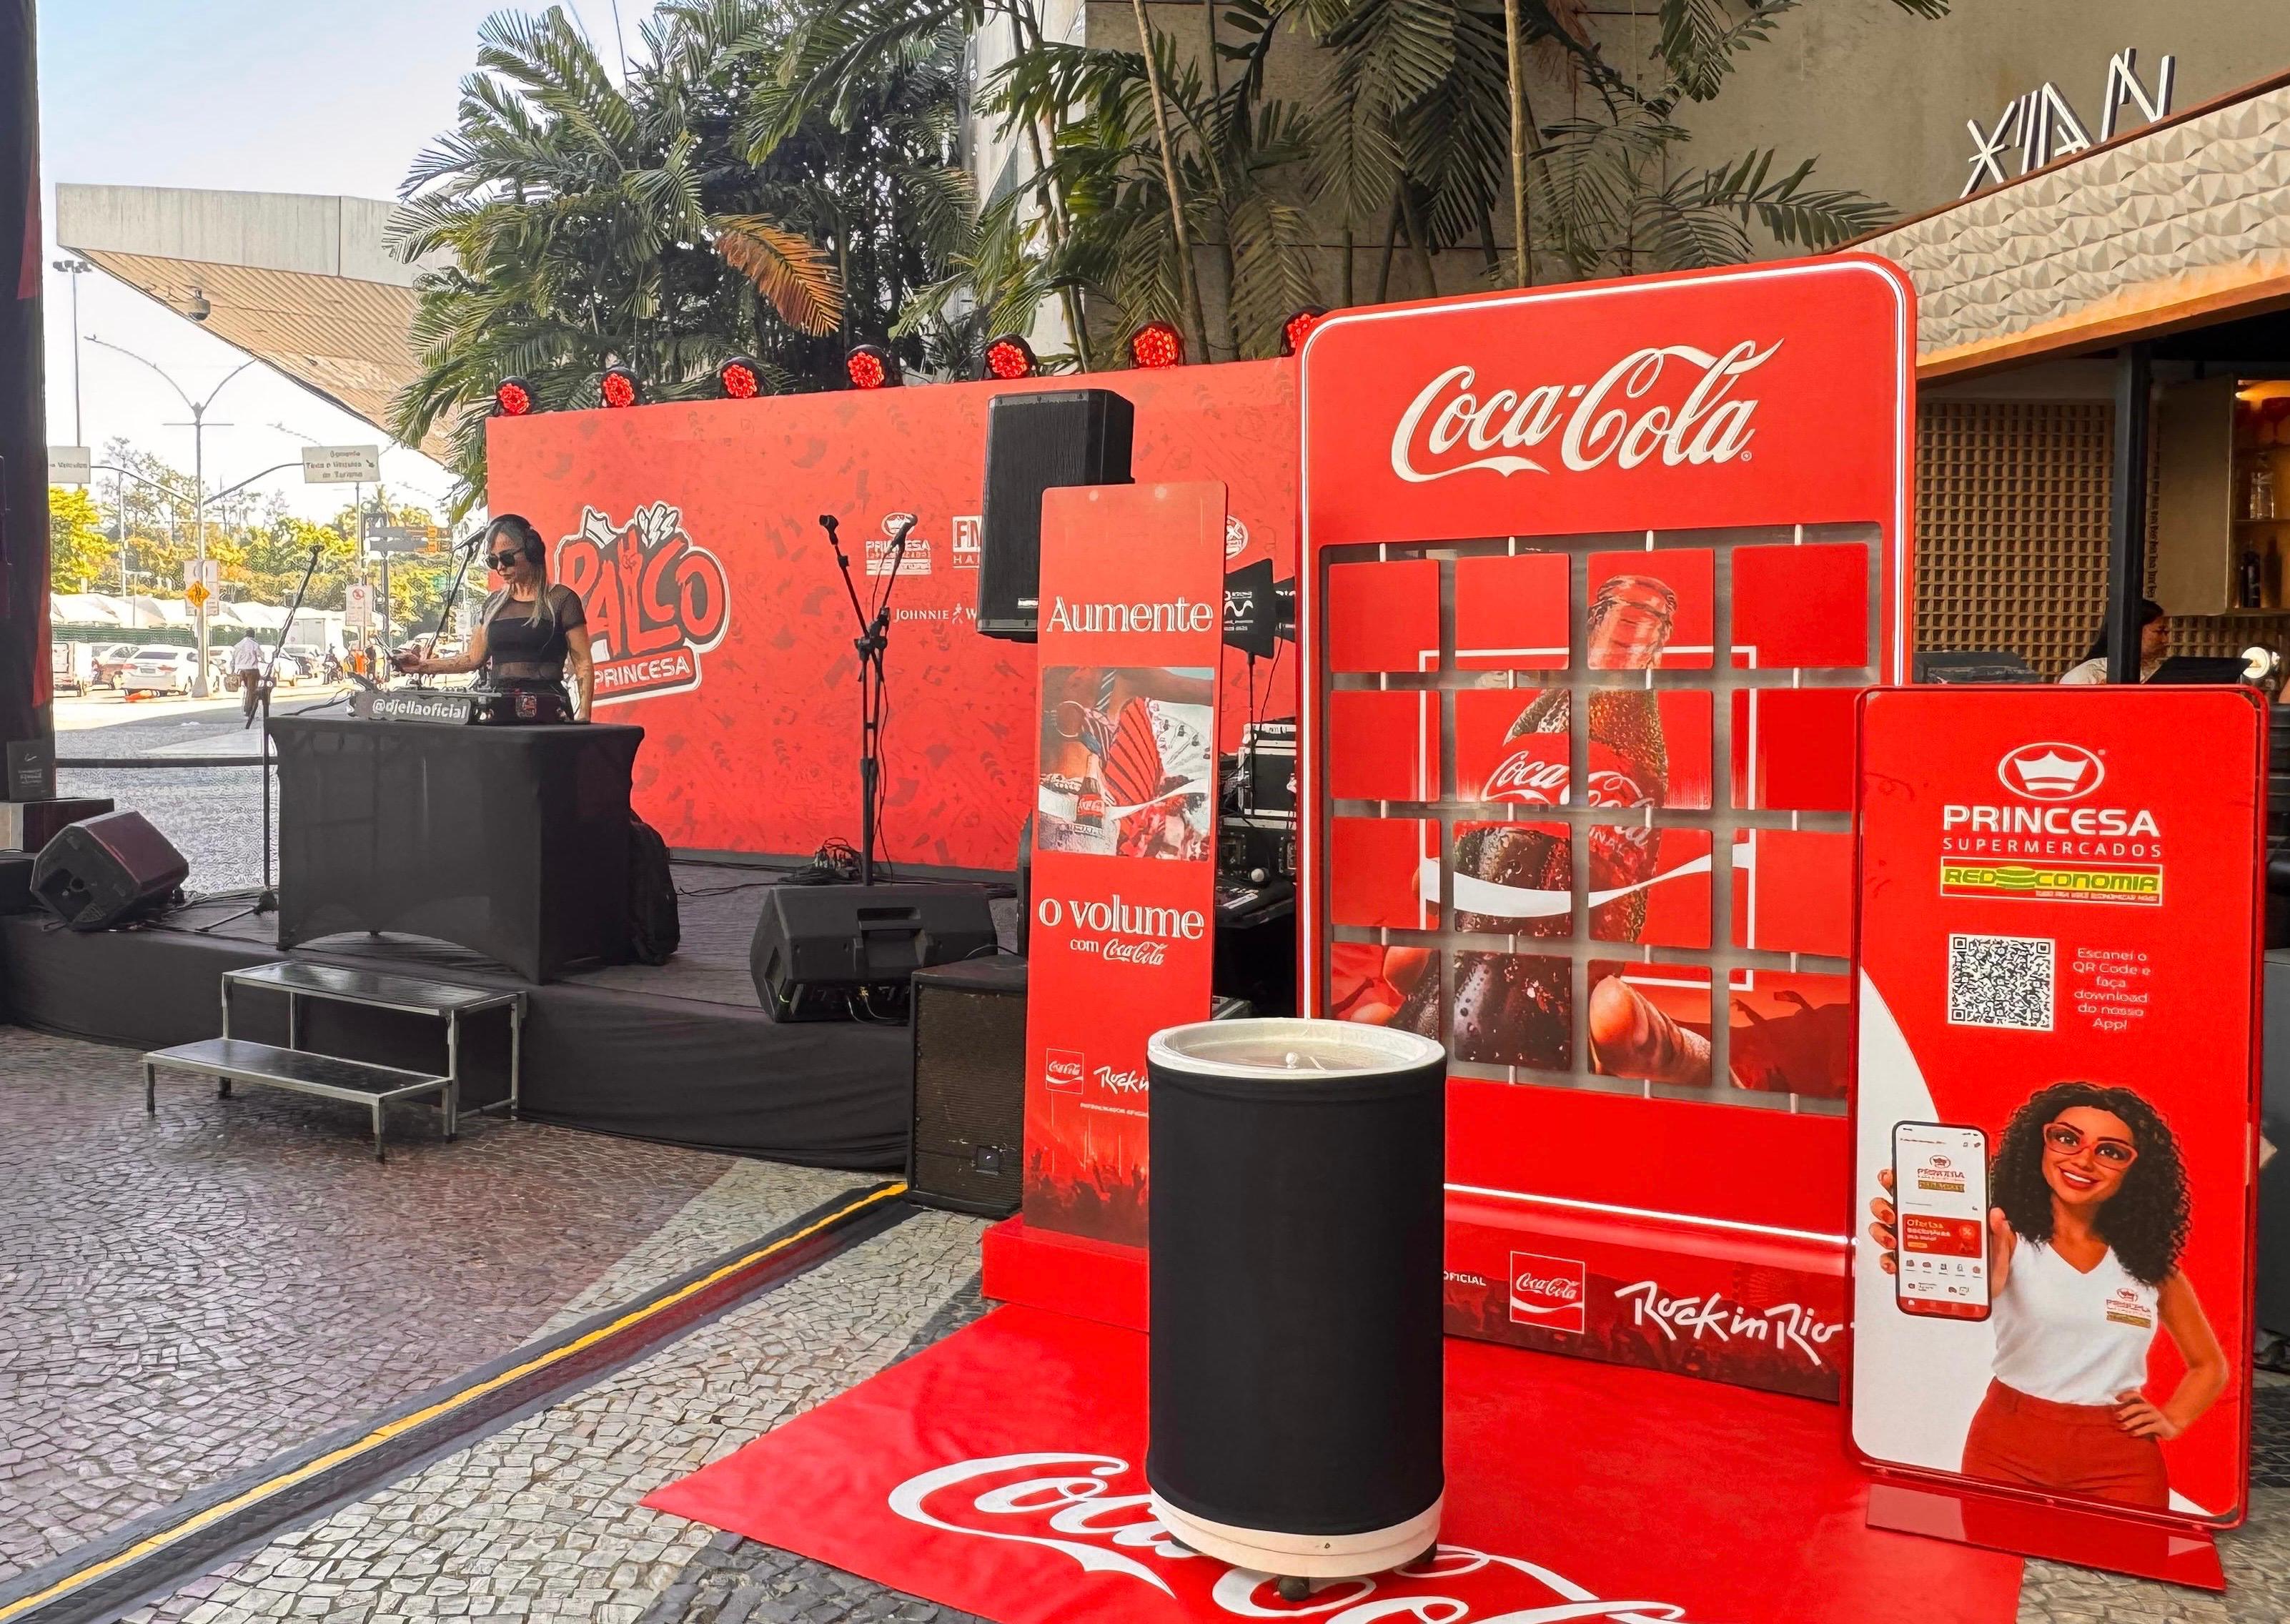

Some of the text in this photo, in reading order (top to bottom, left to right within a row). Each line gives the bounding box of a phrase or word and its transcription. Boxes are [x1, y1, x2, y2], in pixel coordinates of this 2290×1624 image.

[1391, 337, 1785, 482] Coca-Cola
[866, 539, 931, 551] PRIESA
[560, 530, 723, 656] PALCO
[895, 608, 950, 623] JOHNNIE
[1046, 595, 1214, 633] Aumente
[594, 655, 690, 690] PRINCESA
[1943, 804, 2161, 838] PRINCESA
[1942, 837, 2162, 858] SUPERMERCADOS
[1039, 894, 1205, 940] o volume
[1070, 939, 1099, 953] com
[2073, 961, 2096, 973] QR
[2099, 963, 2138, 975] Code
[2096, 975, 2127, 989] faça
[2074, 989, 2148, 1004] download
[2078, 1002, 2144, 1017] do nosso
[1093, 1066, 1139, 1095] Rock
[1615, 1280, 1843, 1366] Rock in Rio
